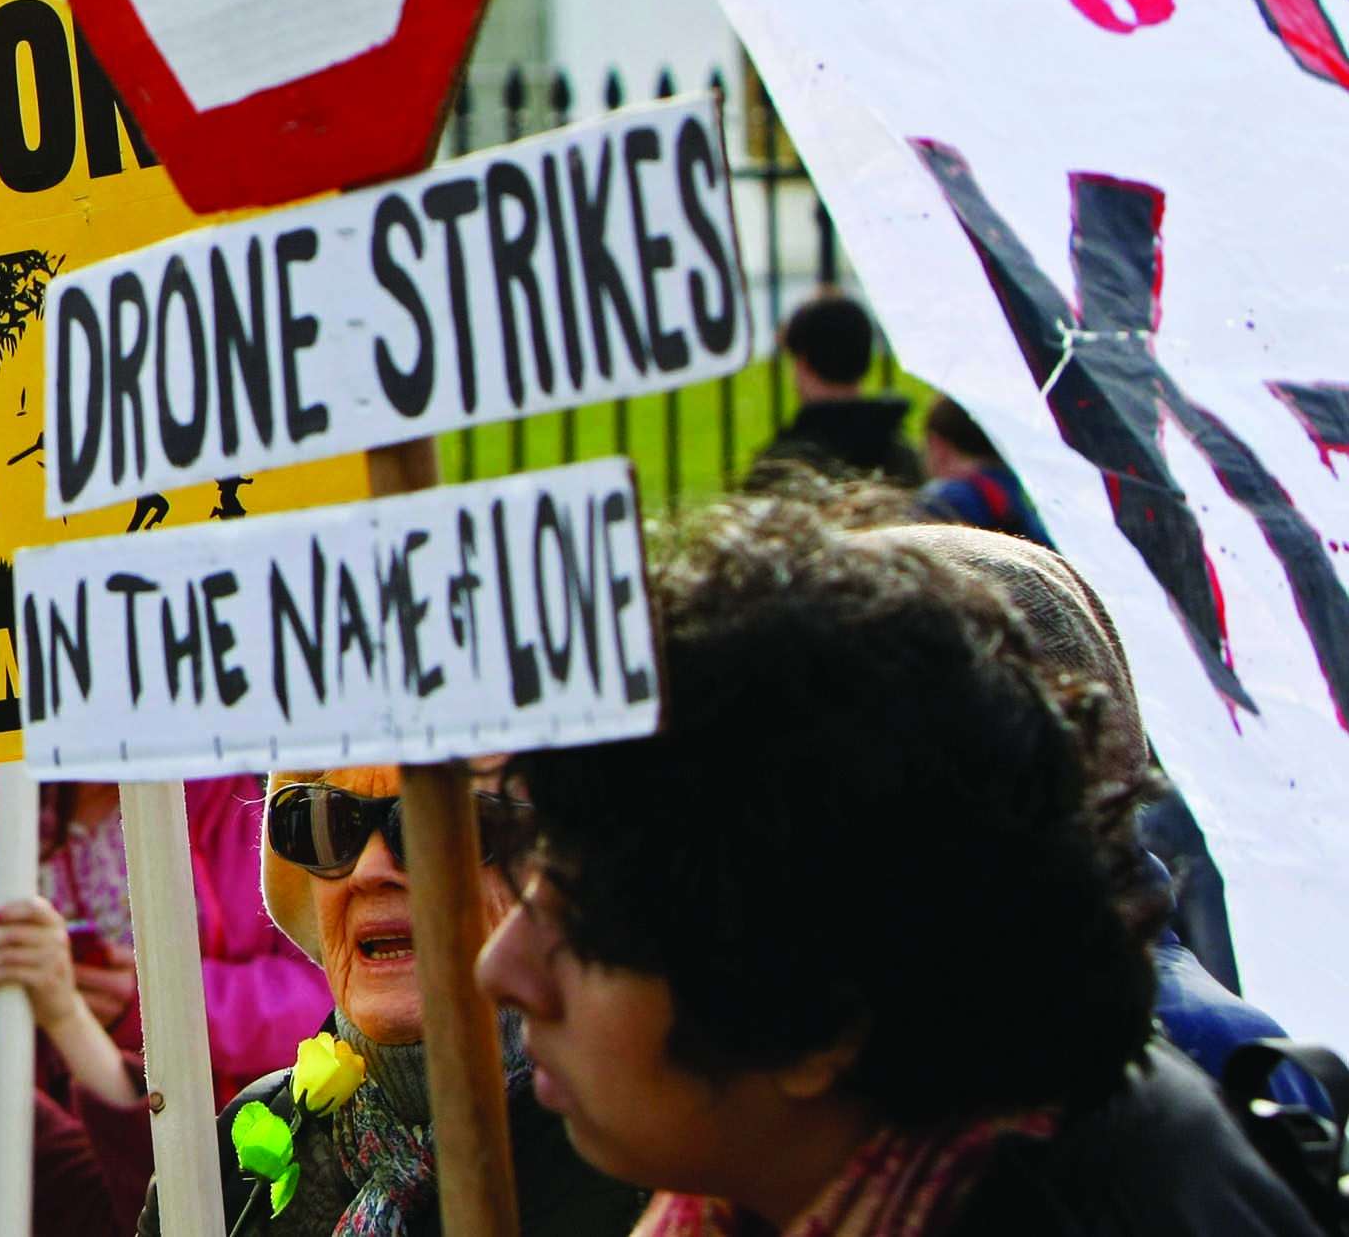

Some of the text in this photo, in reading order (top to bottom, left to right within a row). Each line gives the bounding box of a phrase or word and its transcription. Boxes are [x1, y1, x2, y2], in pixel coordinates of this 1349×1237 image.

[57, 114, 739, 503] DRONE STRIKES
[24, 578, 91, 724] IN
[106, 570, 249, 708] THE
[270, 529, 445, 722] NAME
[491, 491, 651, 708] LOVE
